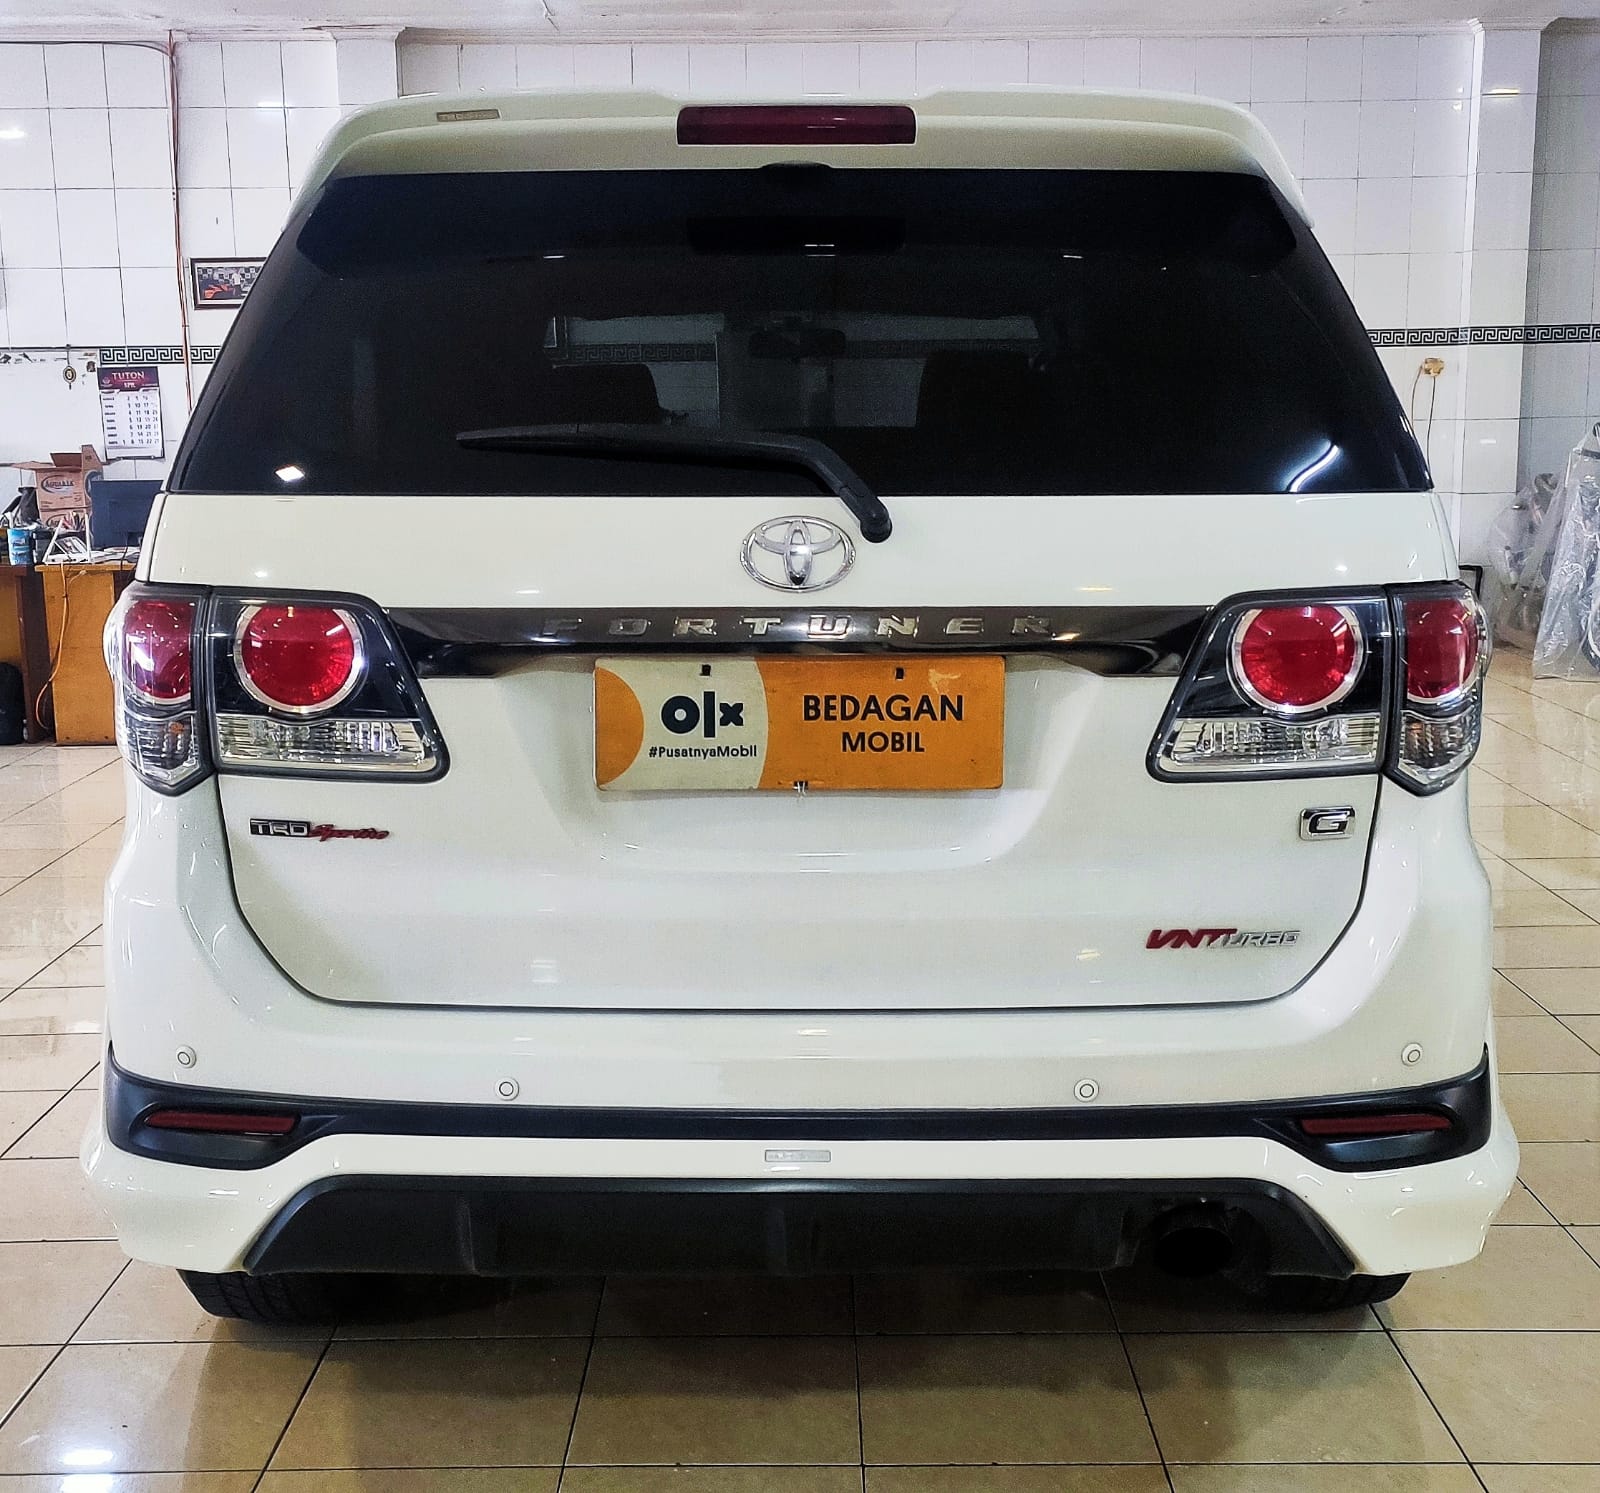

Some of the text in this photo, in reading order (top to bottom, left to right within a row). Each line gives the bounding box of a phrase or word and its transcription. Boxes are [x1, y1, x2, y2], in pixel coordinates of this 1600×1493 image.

[112, 371, 144, 380] TUTON
[542, 616, 1051, 639] FORTUNER
[803, 694, 964, 721] BEDAGAN
[841, 732, 925, 752] MOBIL
[649, 745, 757, 760] #PusatnyaMobil
[250, 819, 309, 837] TRD
[1307, 811, 1350, 836] G
